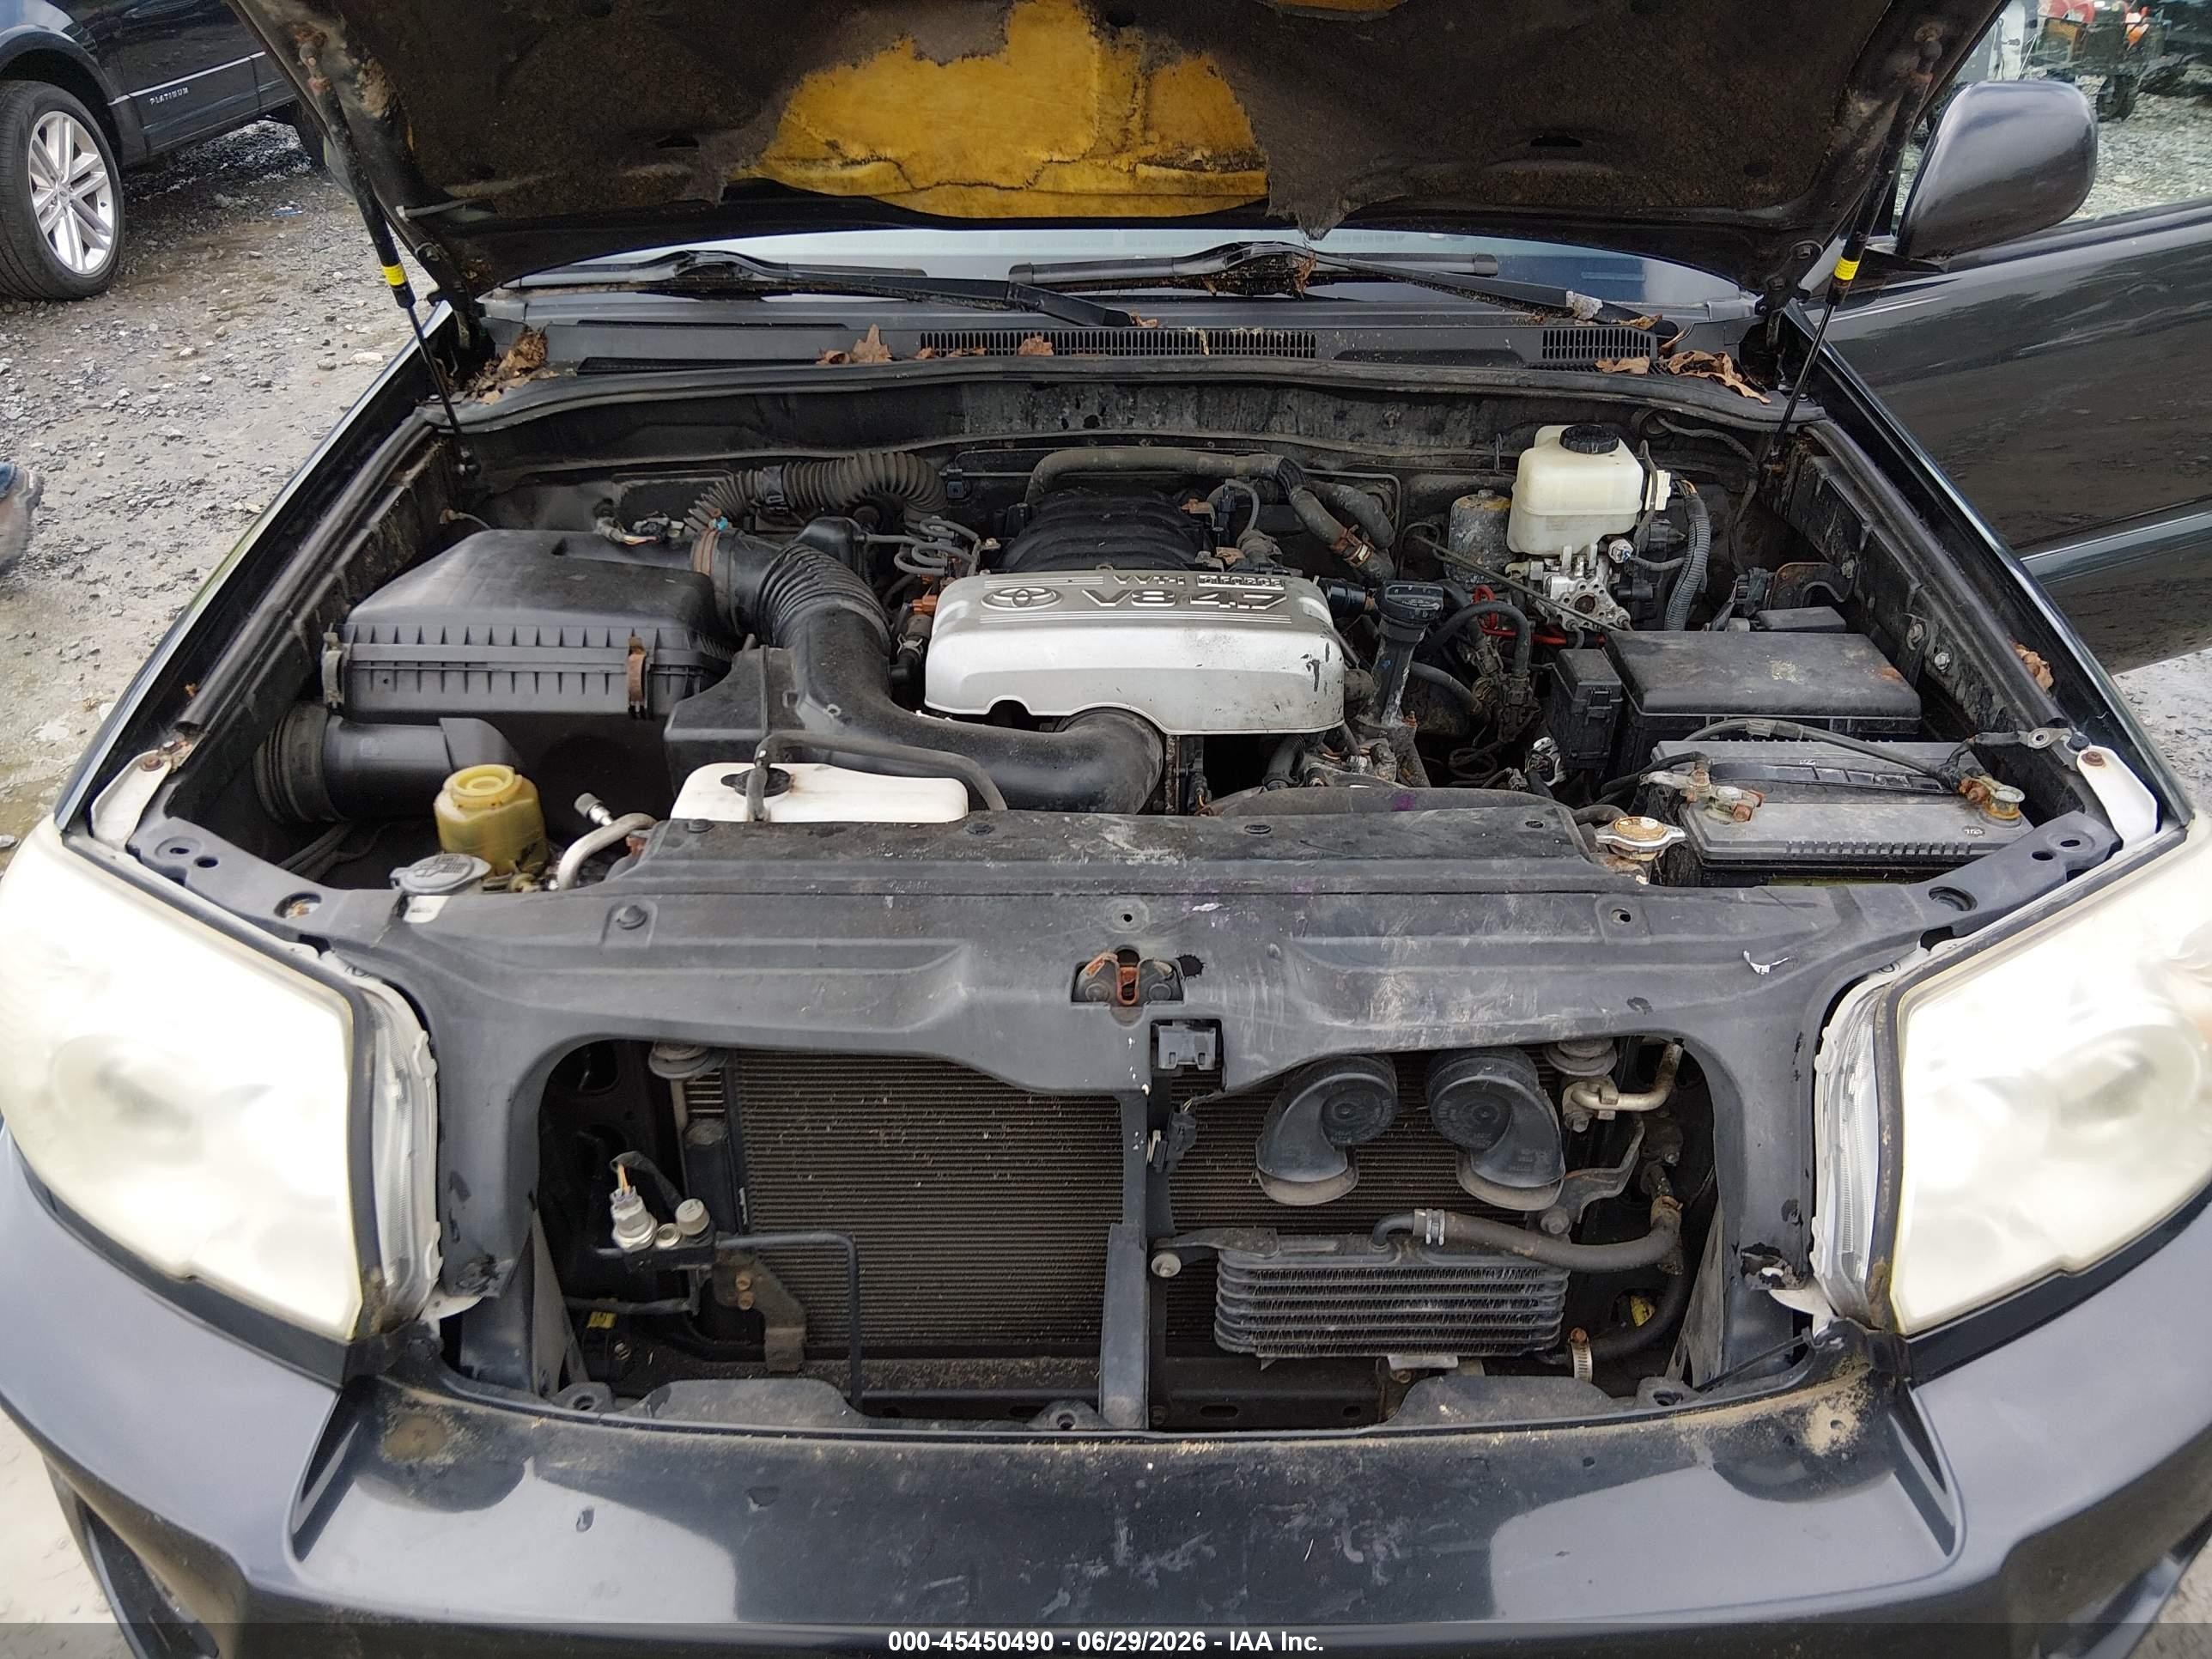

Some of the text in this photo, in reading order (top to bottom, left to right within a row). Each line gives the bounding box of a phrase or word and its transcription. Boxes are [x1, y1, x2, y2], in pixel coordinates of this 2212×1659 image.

[149, 87, 189, 105] PLATINUM
[1081, 589, 1287, 611] V8 4.7
